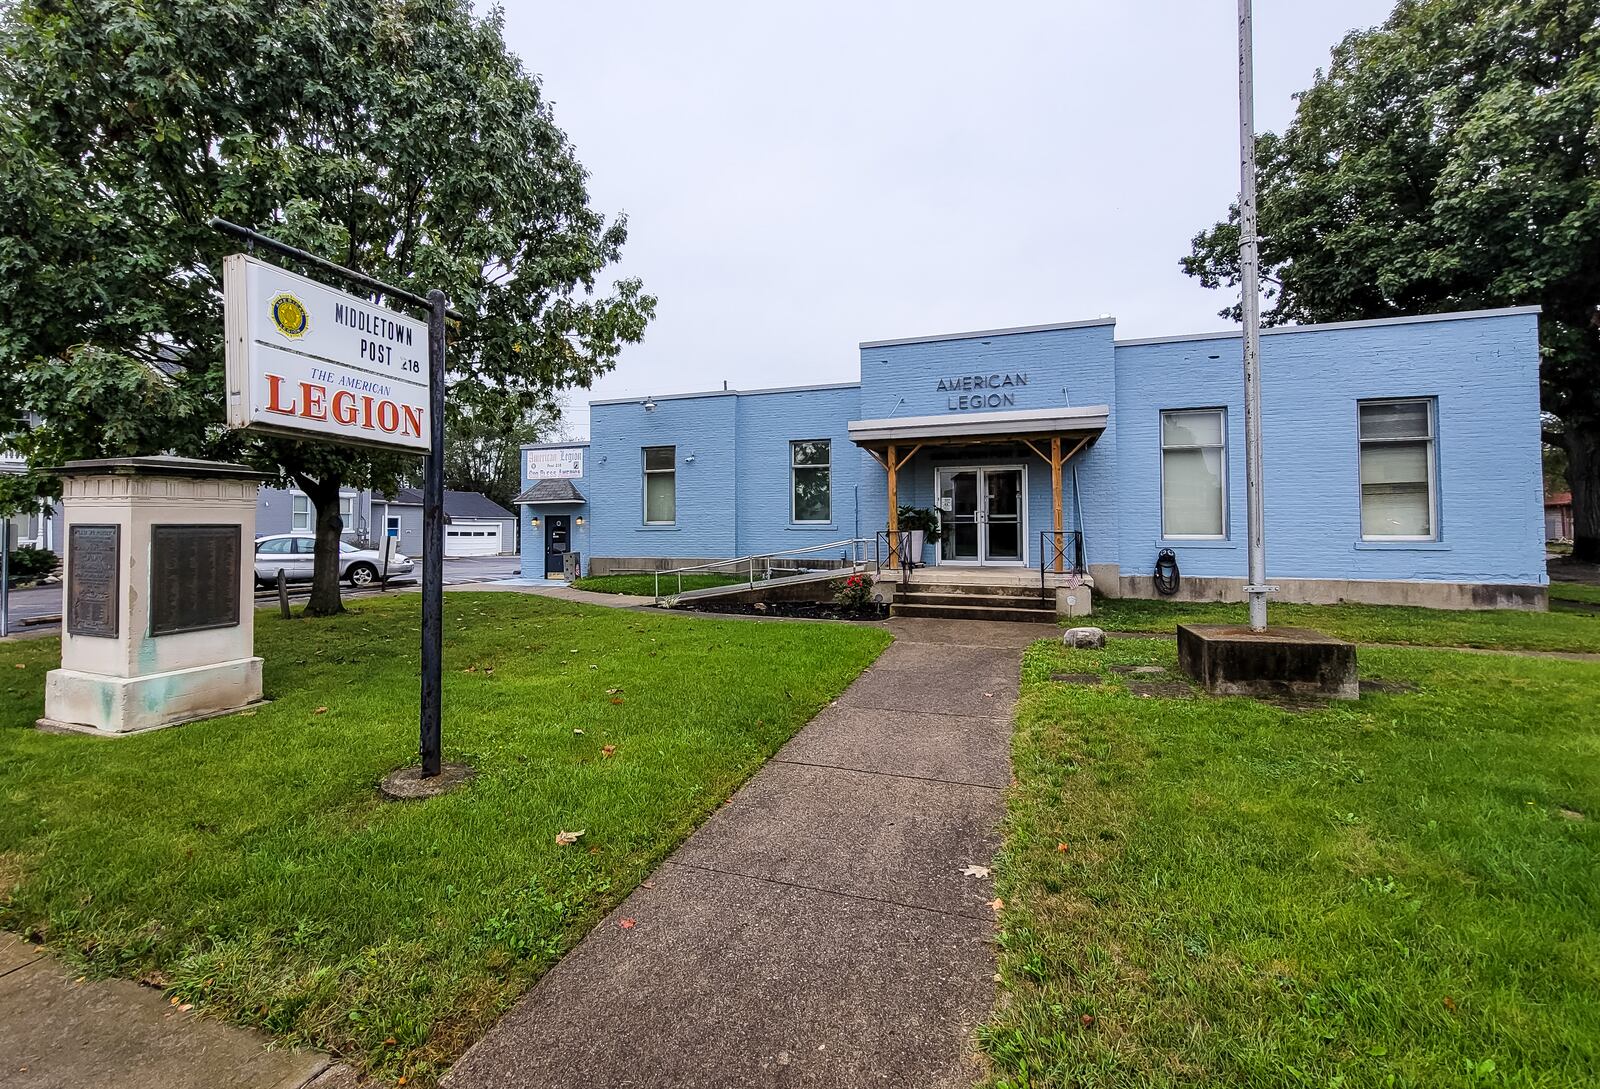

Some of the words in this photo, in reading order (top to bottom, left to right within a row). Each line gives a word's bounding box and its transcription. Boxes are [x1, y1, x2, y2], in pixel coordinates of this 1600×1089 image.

[335, 302, 413, 347] MIDDLETOWN
[360, 339, 393, 366] POST
[311, 368, 335, 384] THE
[338, 375, 392, 397] AMERICAN
[936, 373, 1028, 392] AMERICAN
[264, 373, 424, 438] LEGION
[948, 392, 1015, 410] LEGION
[560, 450, 582, 463] Legion
